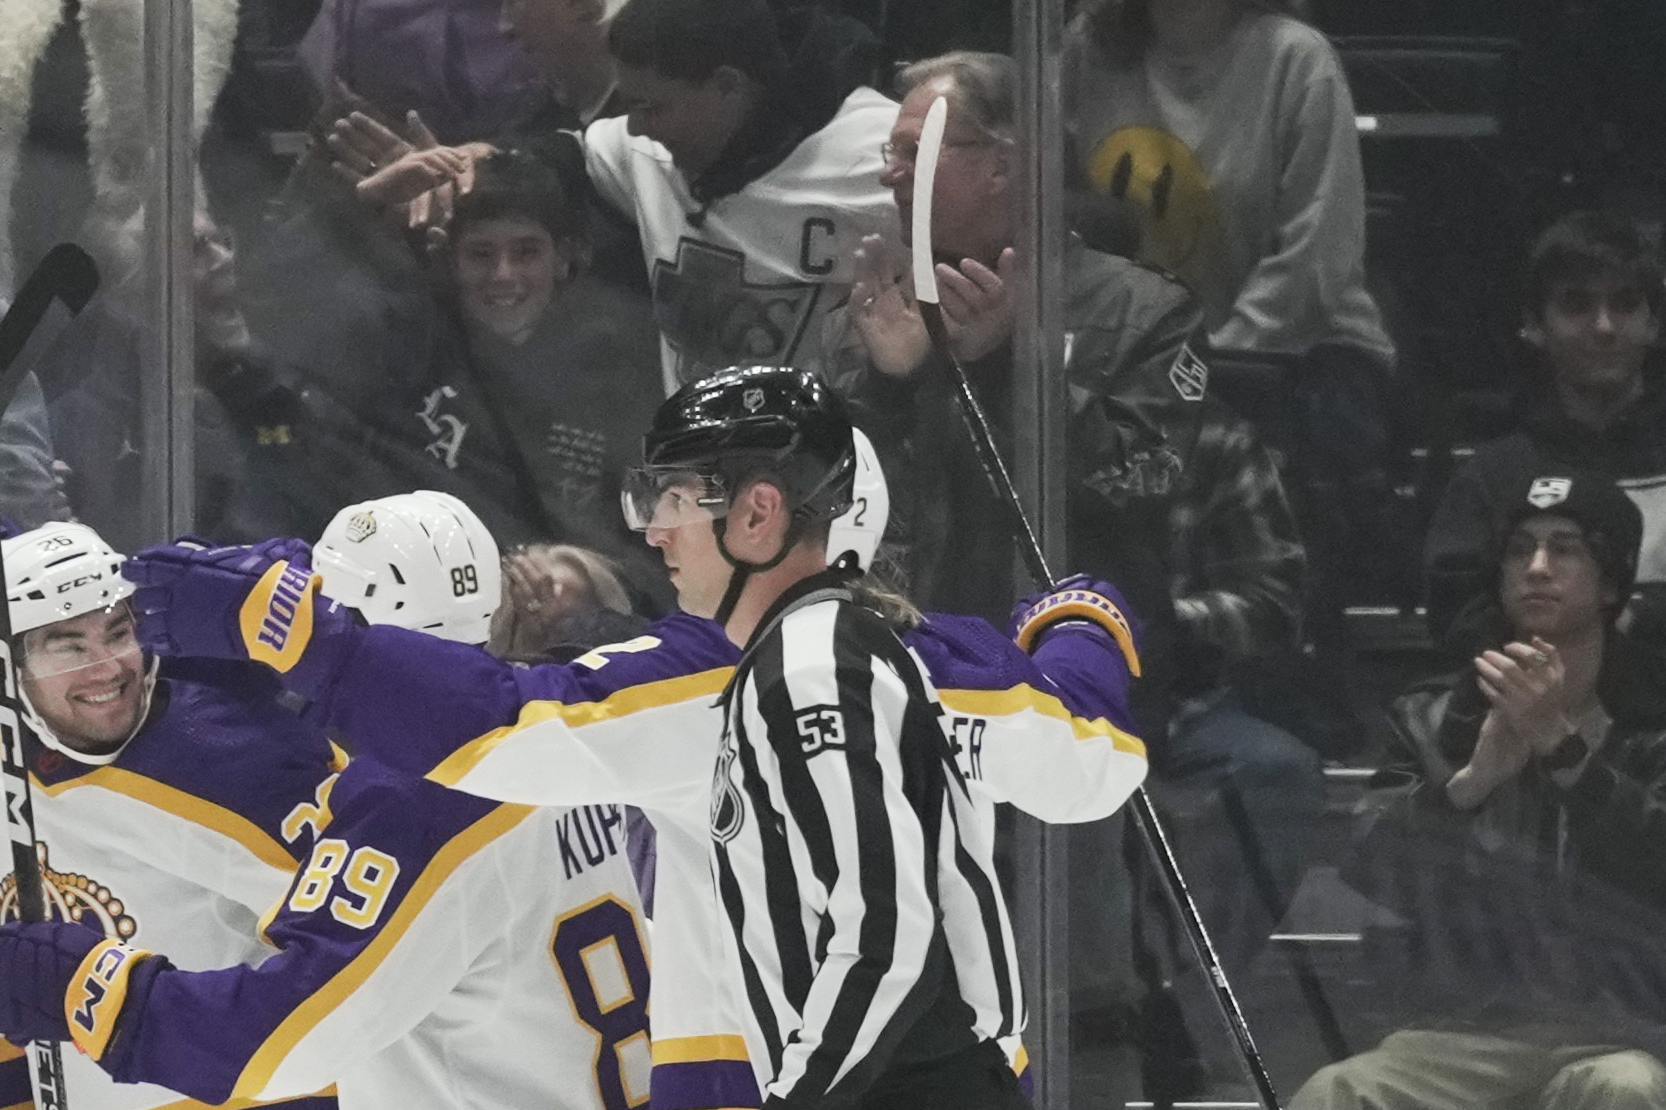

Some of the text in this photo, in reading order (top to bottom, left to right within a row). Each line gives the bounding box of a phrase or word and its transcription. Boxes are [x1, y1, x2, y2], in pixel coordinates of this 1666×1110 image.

[799, 216, 835, 276] C
[853, 497, 868, 527] 2
[36, 534, 74, 552] 26
[450, 563, 479, 598] 89
[795, 710, 847, 753] 53
[555, 803, 628, 881] KUP
[288, 837, 401, 930] 89
[72, 946, 127, 1036] CM
